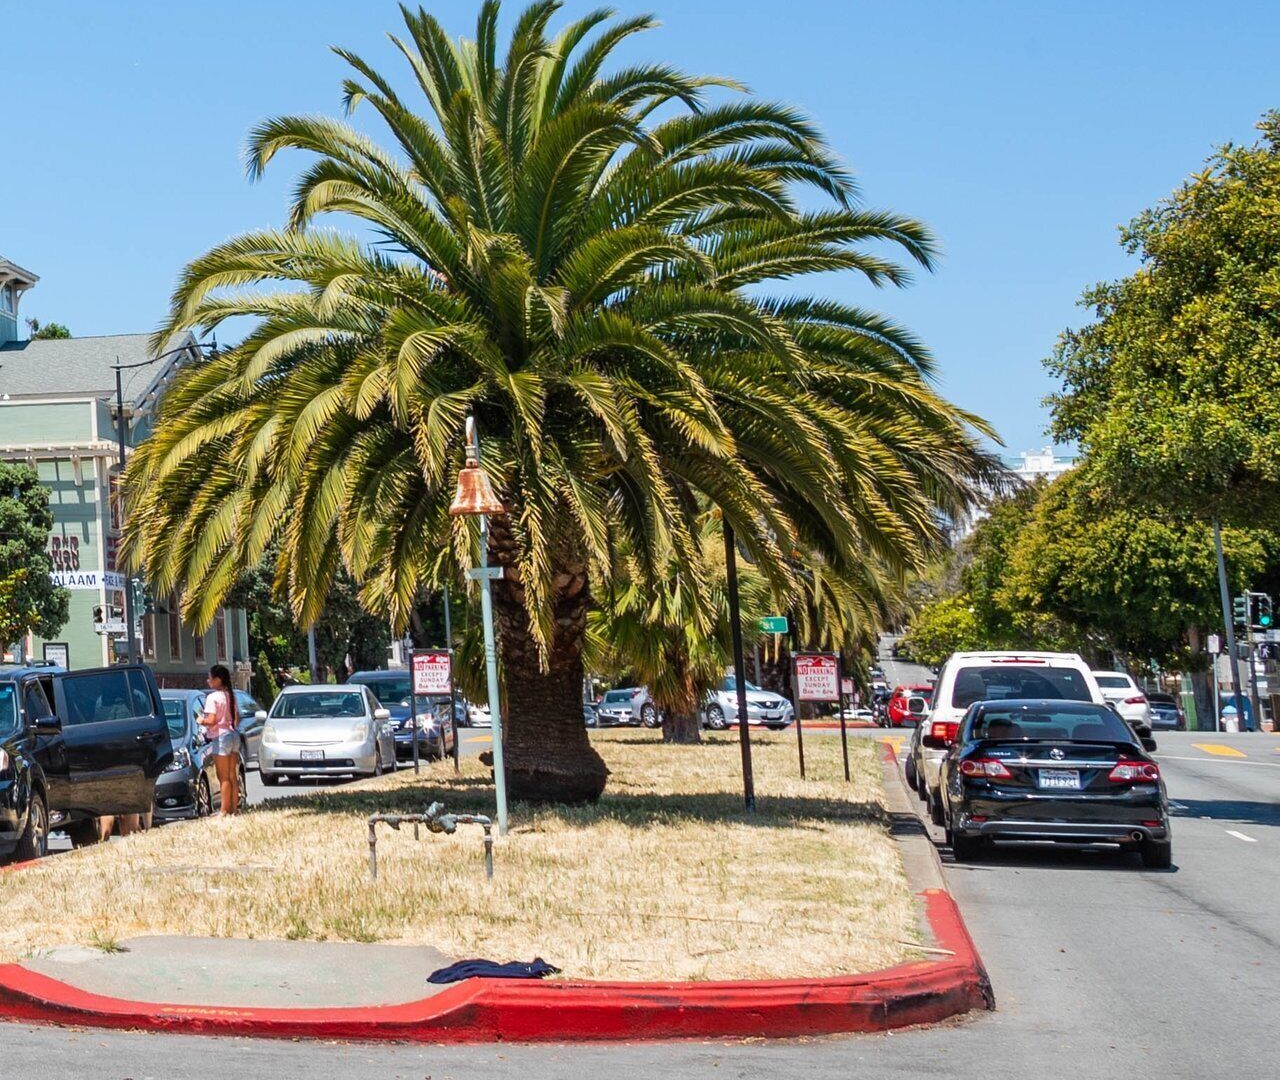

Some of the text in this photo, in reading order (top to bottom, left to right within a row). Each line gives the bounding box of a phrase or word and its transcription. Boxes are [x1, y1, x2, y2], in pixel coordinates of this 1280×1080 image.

[52, 574, 96, 586] ALAAM
[798, 665, 834, 675] NO PARKING
